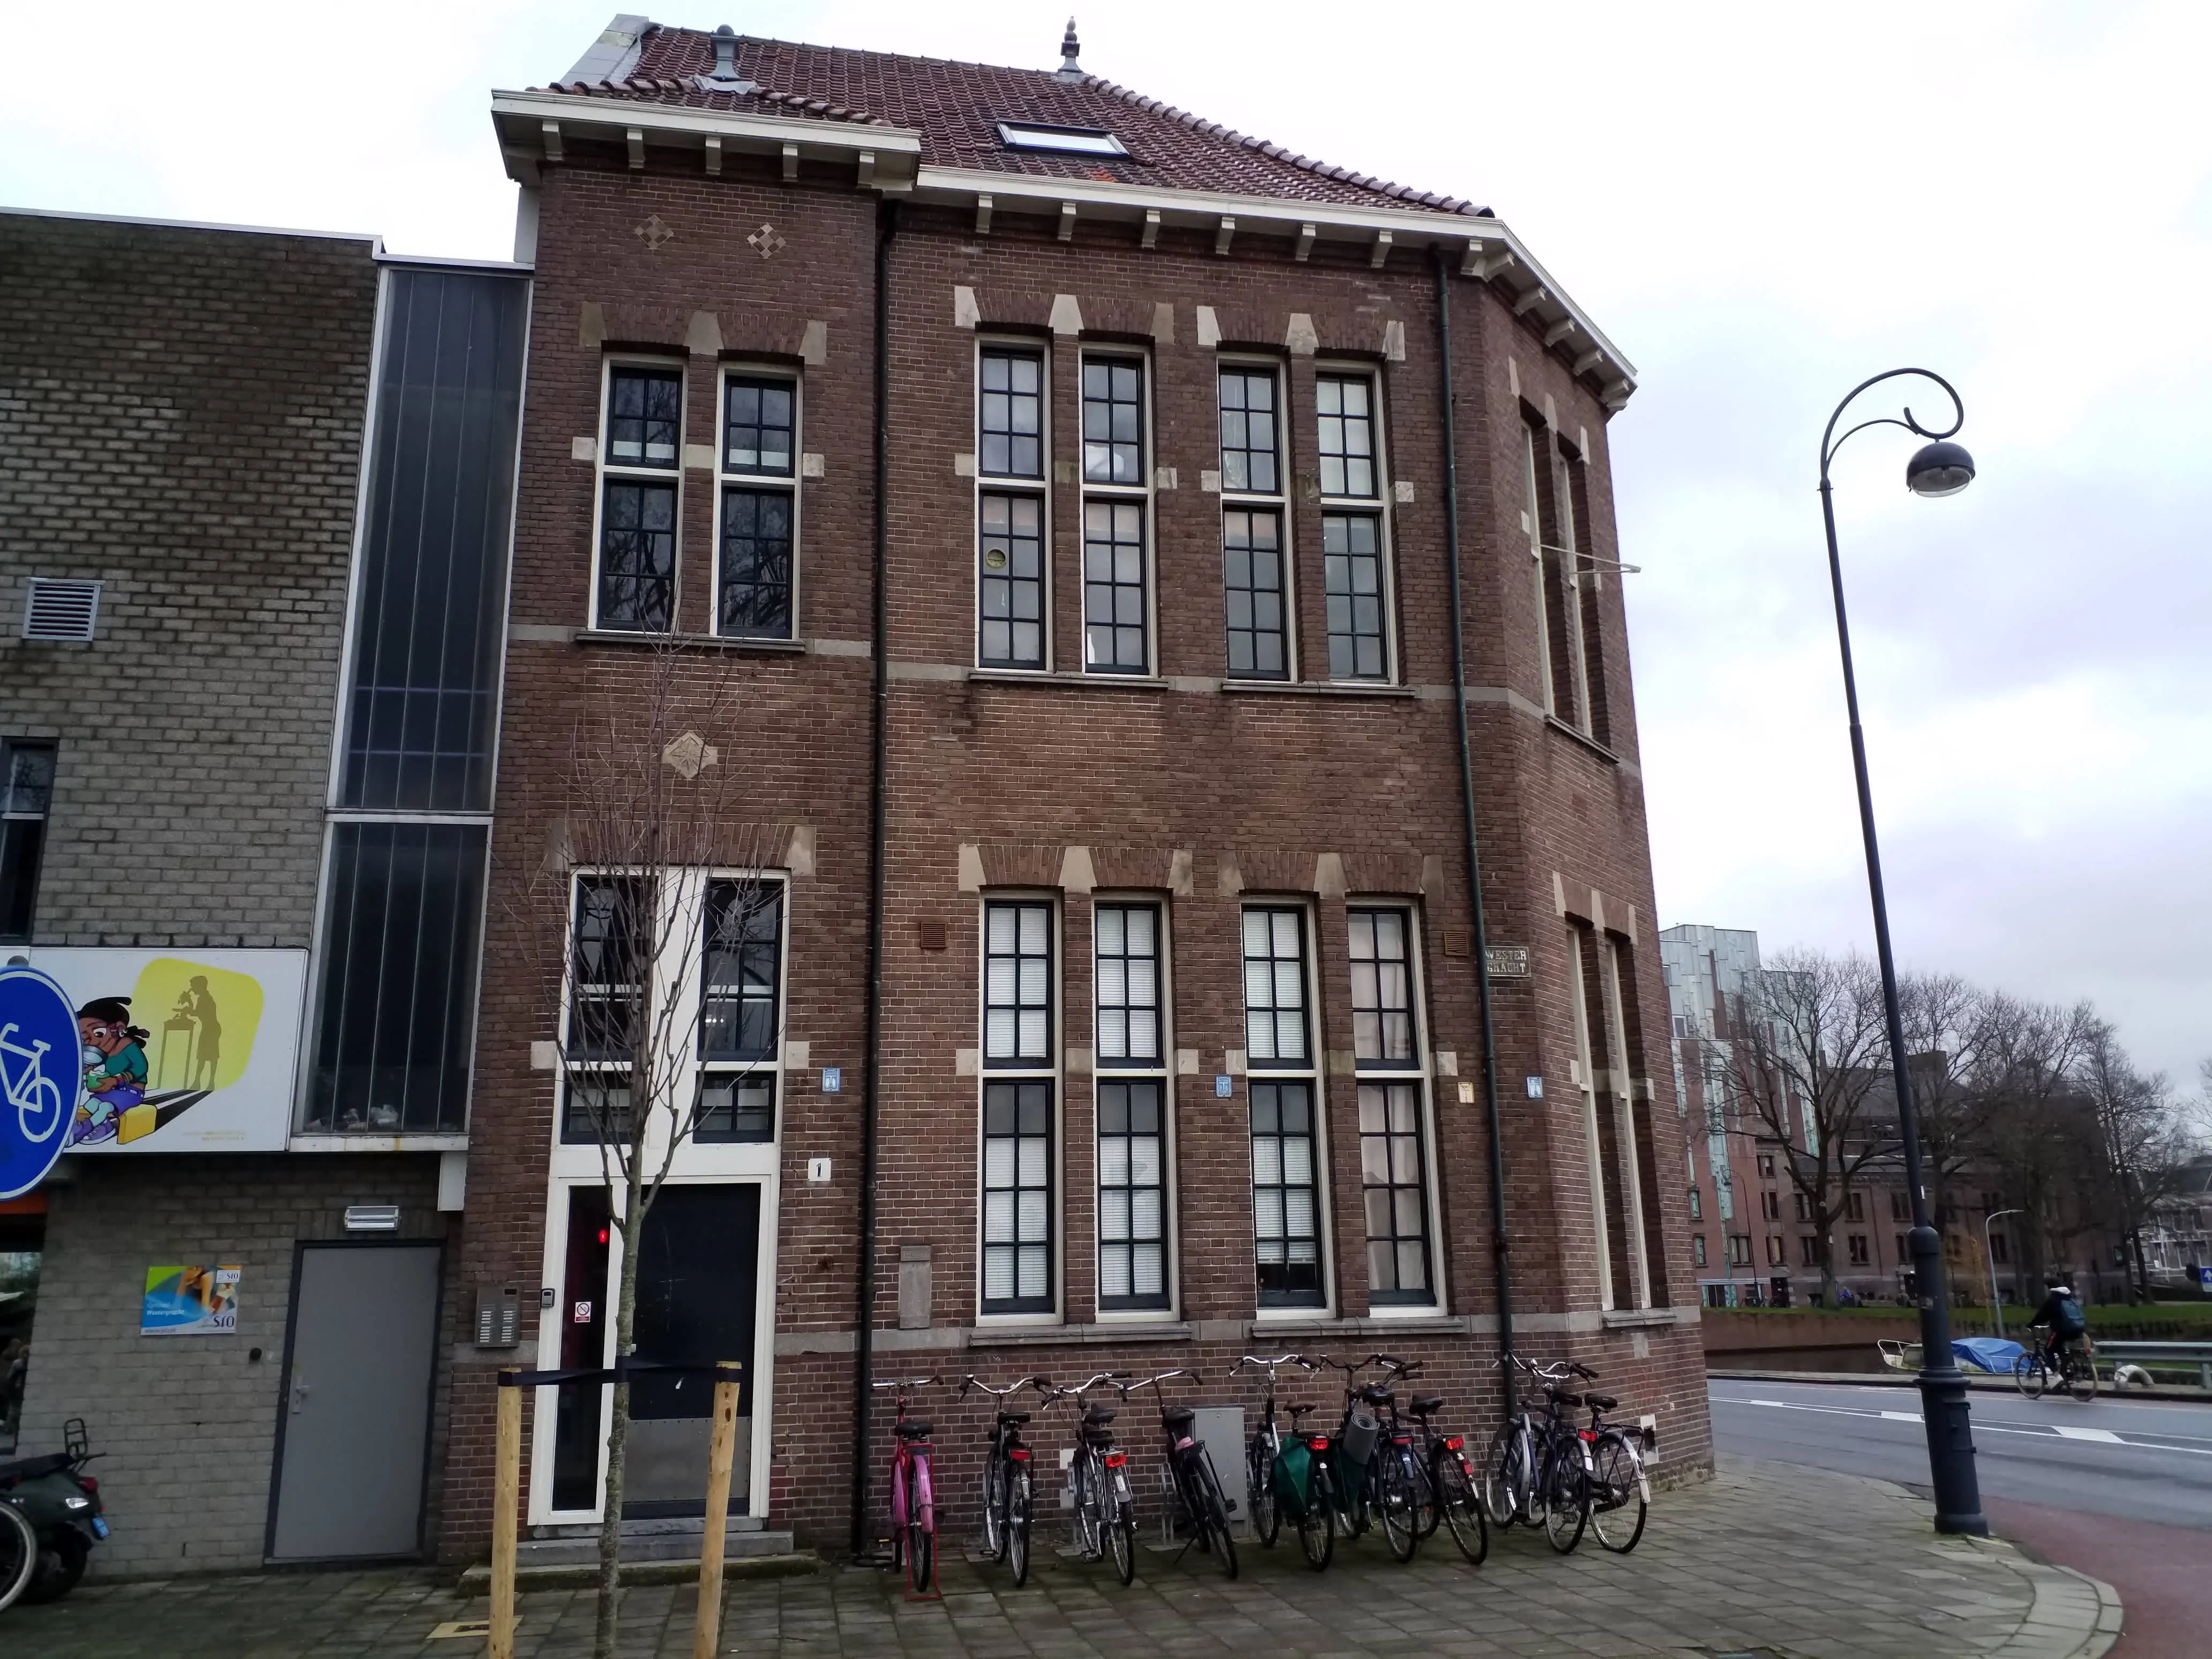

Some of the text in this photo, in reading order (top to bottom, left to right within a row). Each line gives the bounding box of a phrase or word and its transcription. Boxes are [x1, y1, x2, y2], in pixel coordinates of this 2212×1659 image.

[1485, 950, 1527, 960] WESTER
[1487, 962, 1526, 973] GRACHT
[816, 1162, 821, 1177] 1
